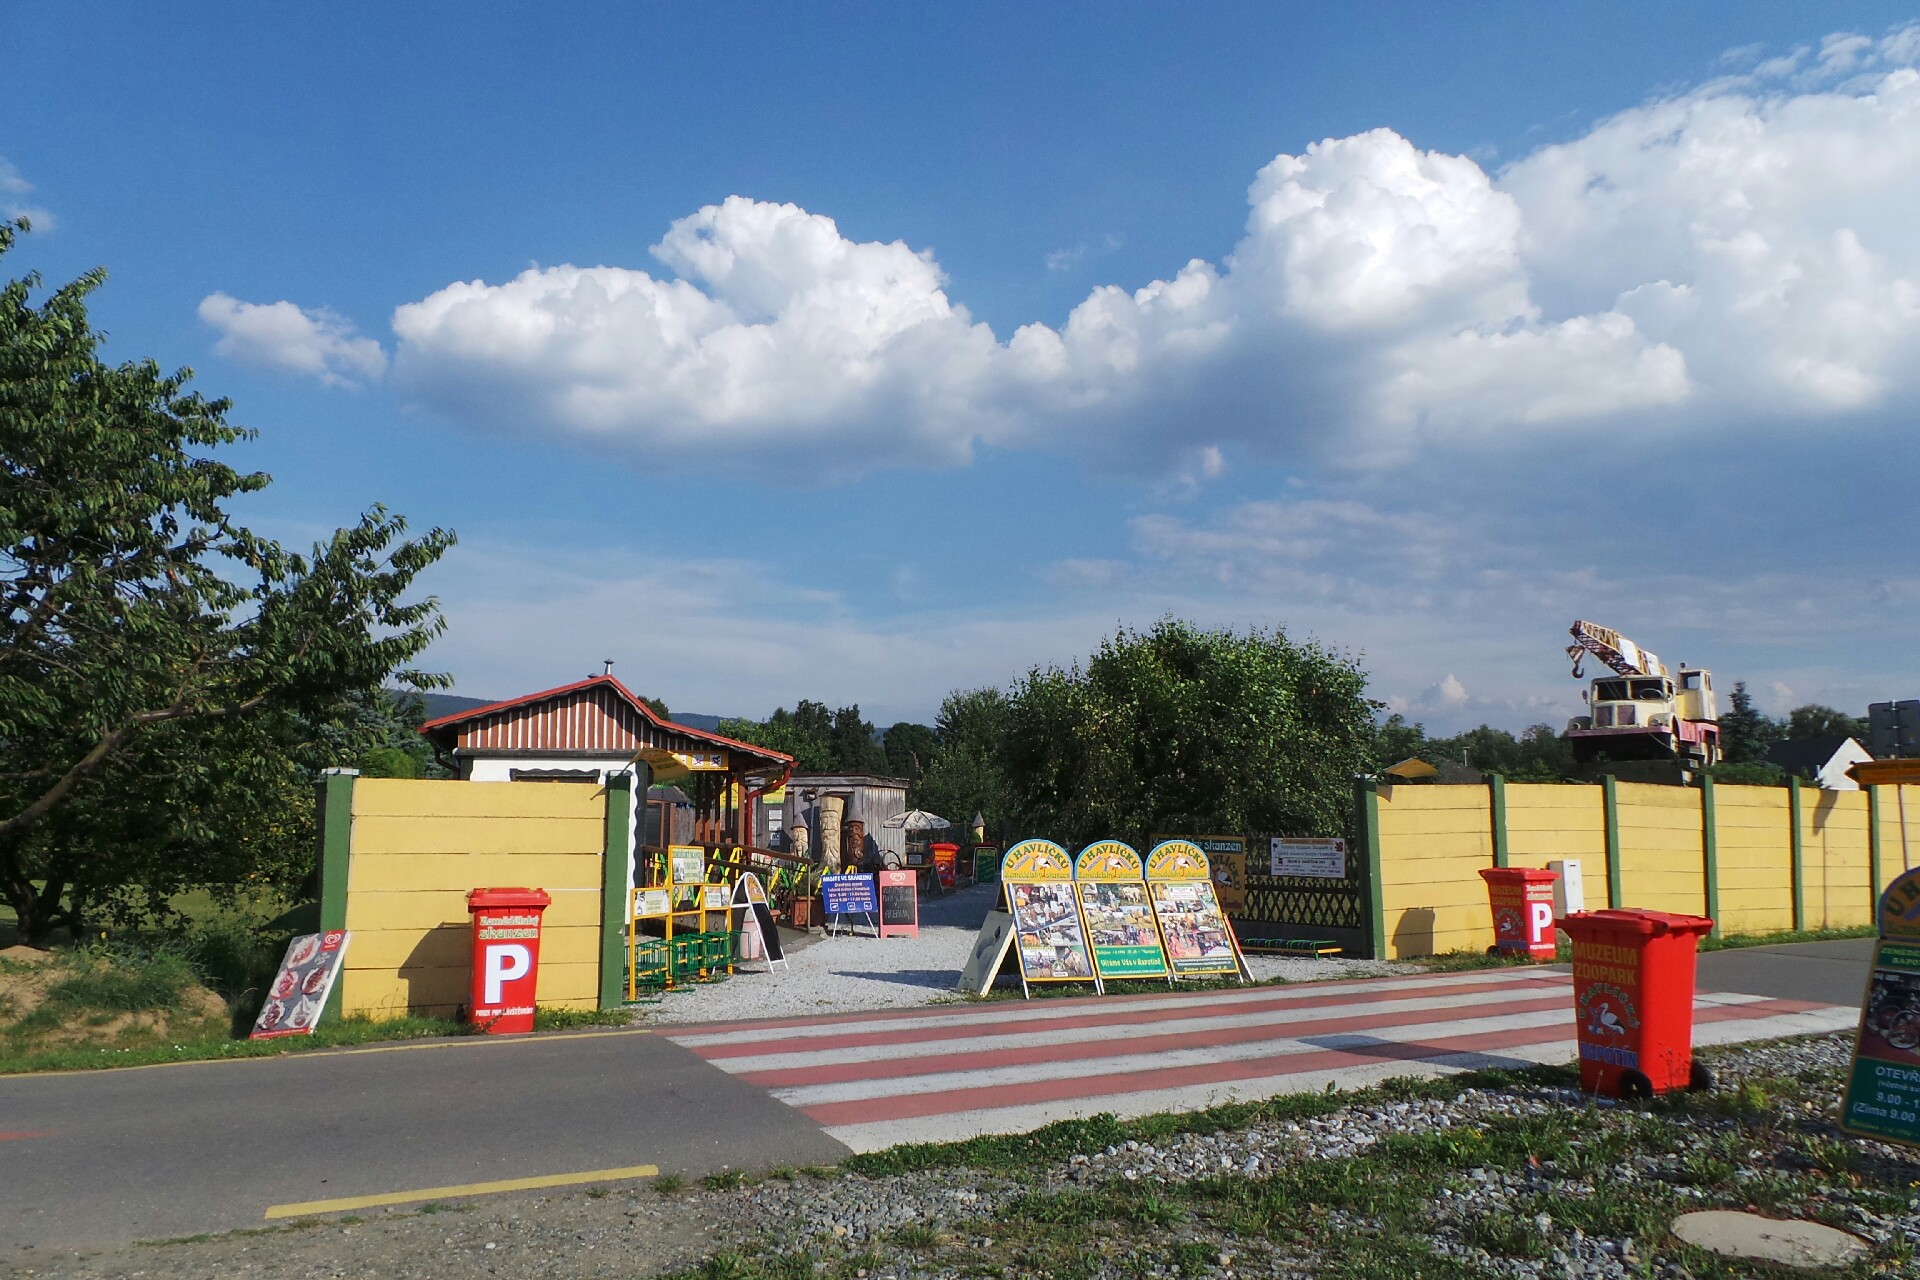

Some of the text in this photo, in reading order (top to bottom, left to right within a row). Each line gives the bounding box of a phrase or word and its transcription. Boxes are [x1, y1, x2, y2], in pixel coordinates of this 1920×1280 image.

[1204, 839, 1241, 852] skanzen
[1006, 858, 1015, 868] U
[1078, 860, 1088, 870] U
[1149, 860, 1158, 869] U
[1531, 903, 1553, 943] P
[479, 926, 539, 939] skanzen
[1574, 941, 1638, 966] MUZEUM
[484, 944, 532, 1004] P
[1575, 962, 1637, 986] ZOOPARK
[1580, 1041, 1638, 1069] RAPOTÍN
[1876, 1092, 1902, 1105] 9.00
[1890, 1109, 1916, 1122] 9.00
